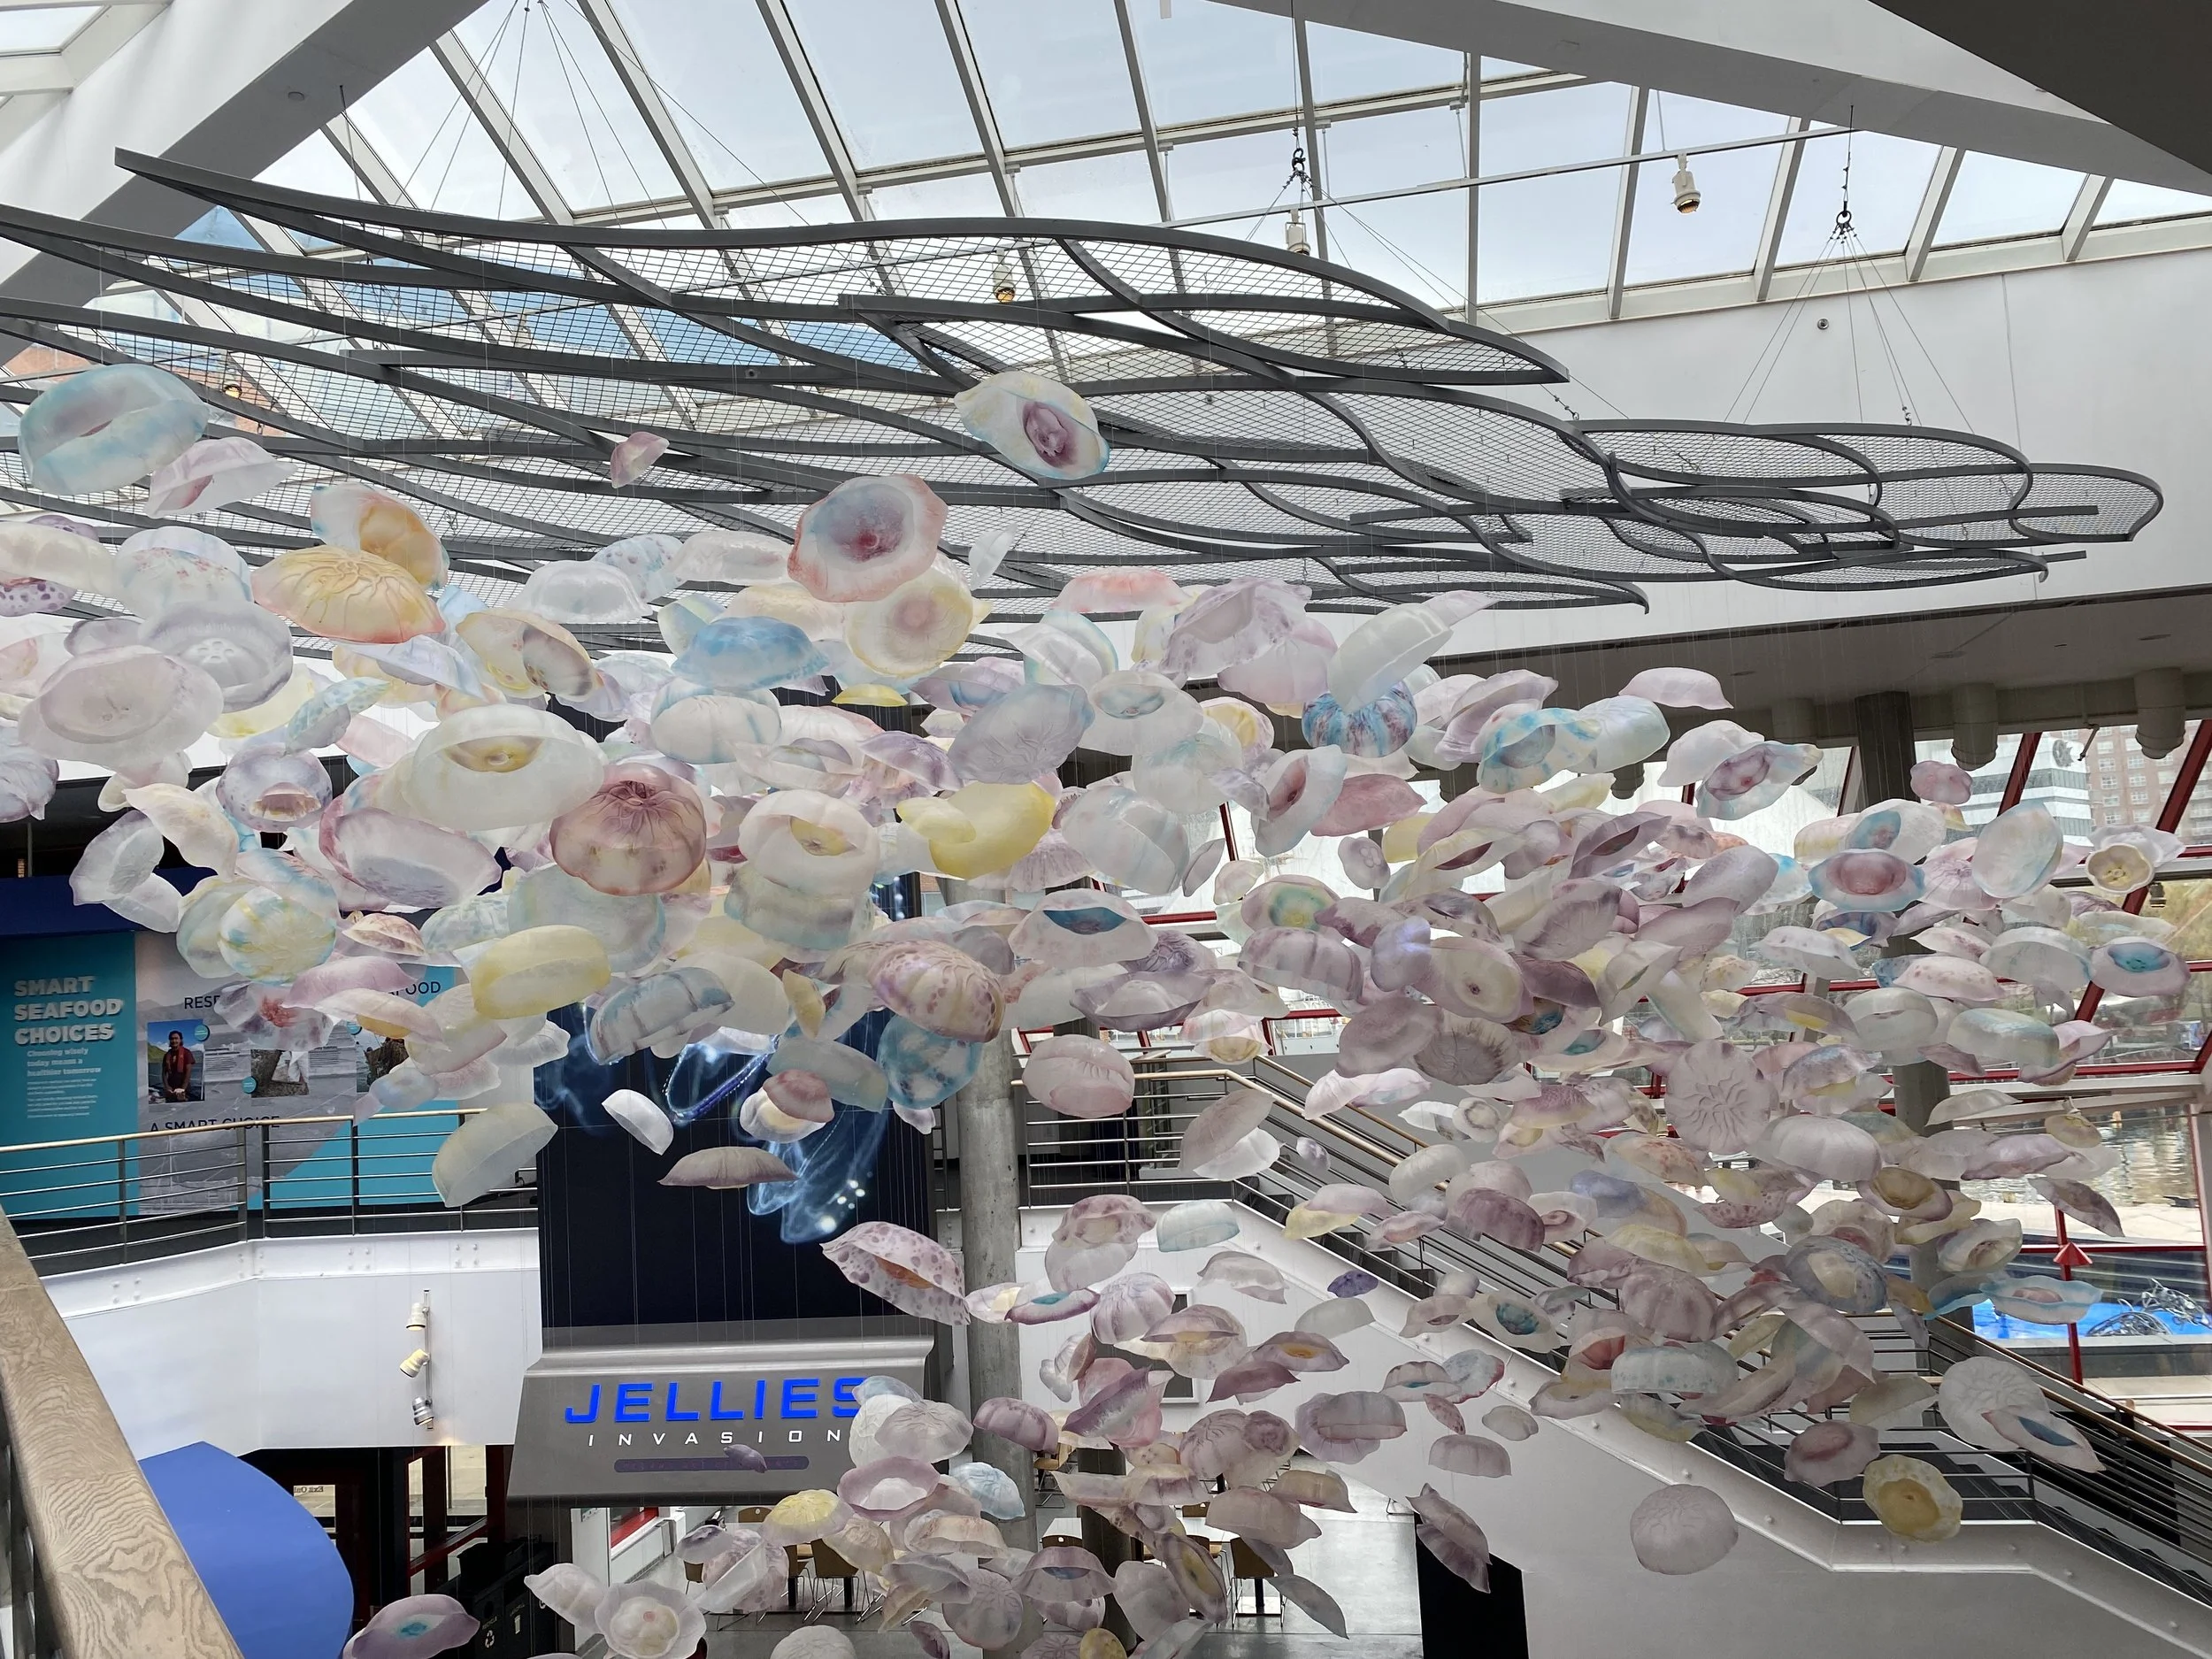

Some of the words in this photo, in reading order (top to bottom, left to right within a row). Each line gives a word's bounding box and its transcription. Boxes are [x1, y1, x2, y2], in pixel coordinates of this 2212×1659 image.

[14, 976, 95, 996] SMART
[14, 999, 123, 1021] SEAFOOD
[14, 1023, 114, 1045] CHOICES
[150, 1123, 158, 1132] A
[565, 1377, 868, 1424] JELLIES
[588, 1429, 841, 1447] INVASION
